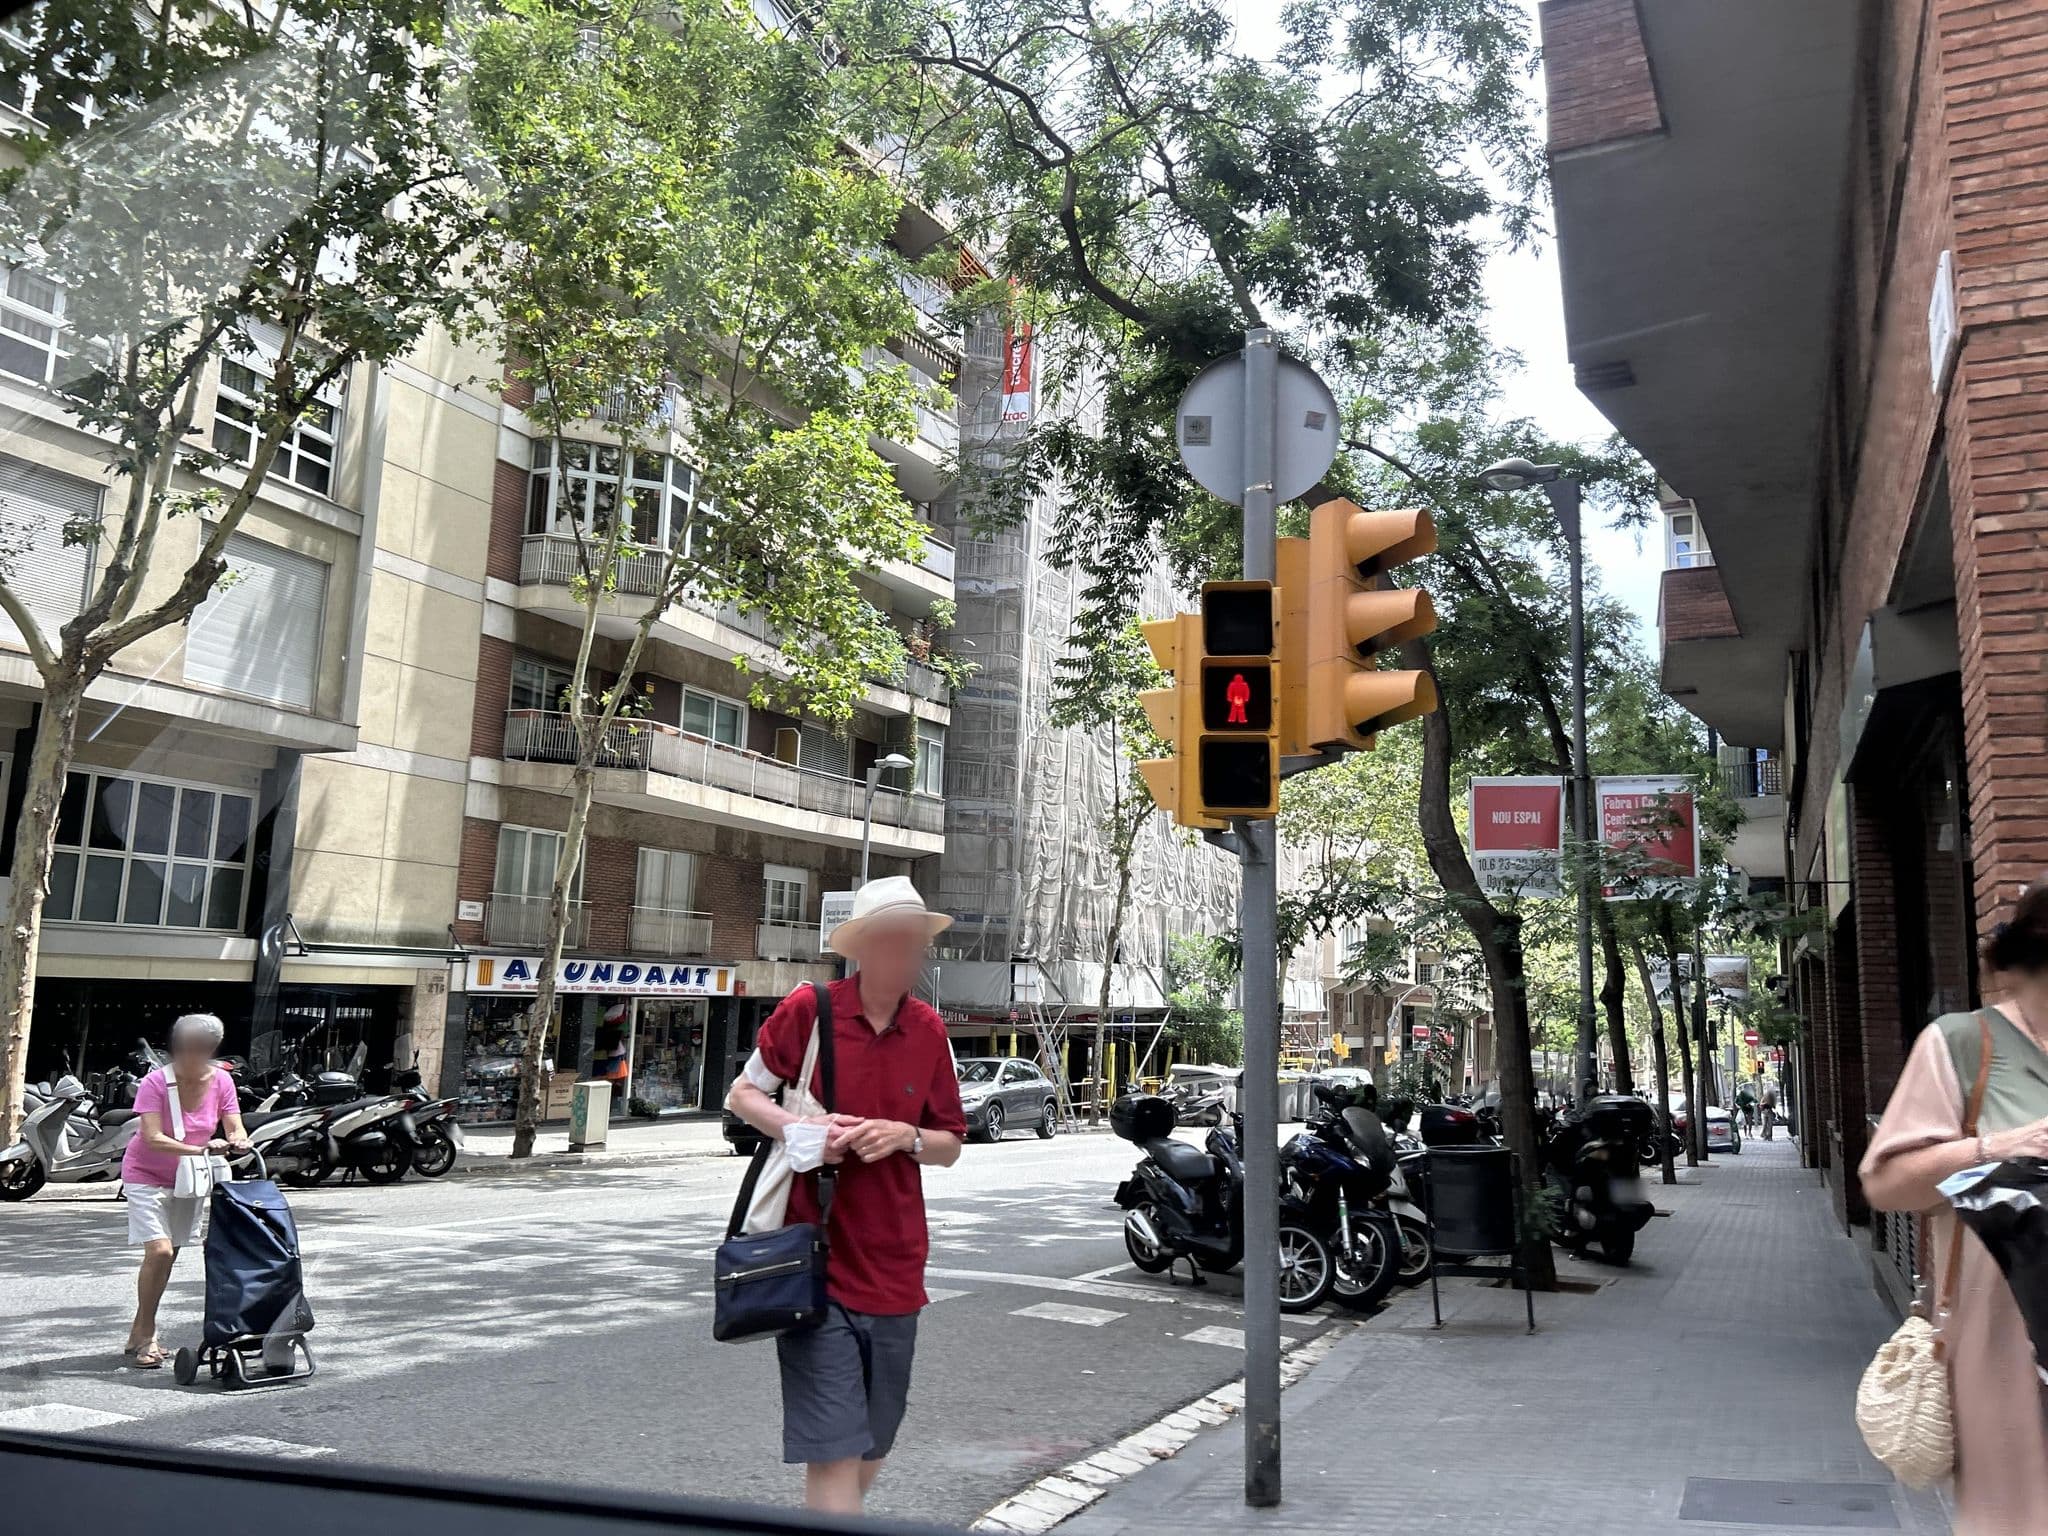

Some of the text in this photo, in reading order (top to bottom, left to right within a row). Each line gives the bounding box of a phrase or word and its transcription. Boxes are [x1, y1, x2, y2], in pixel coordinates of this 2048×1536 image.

[1604, 796, 1632, 810] Fabra
[1492, 811, 1541, 824] NOU ESPAI
[502, 959, 710, 986] AUNDANT
